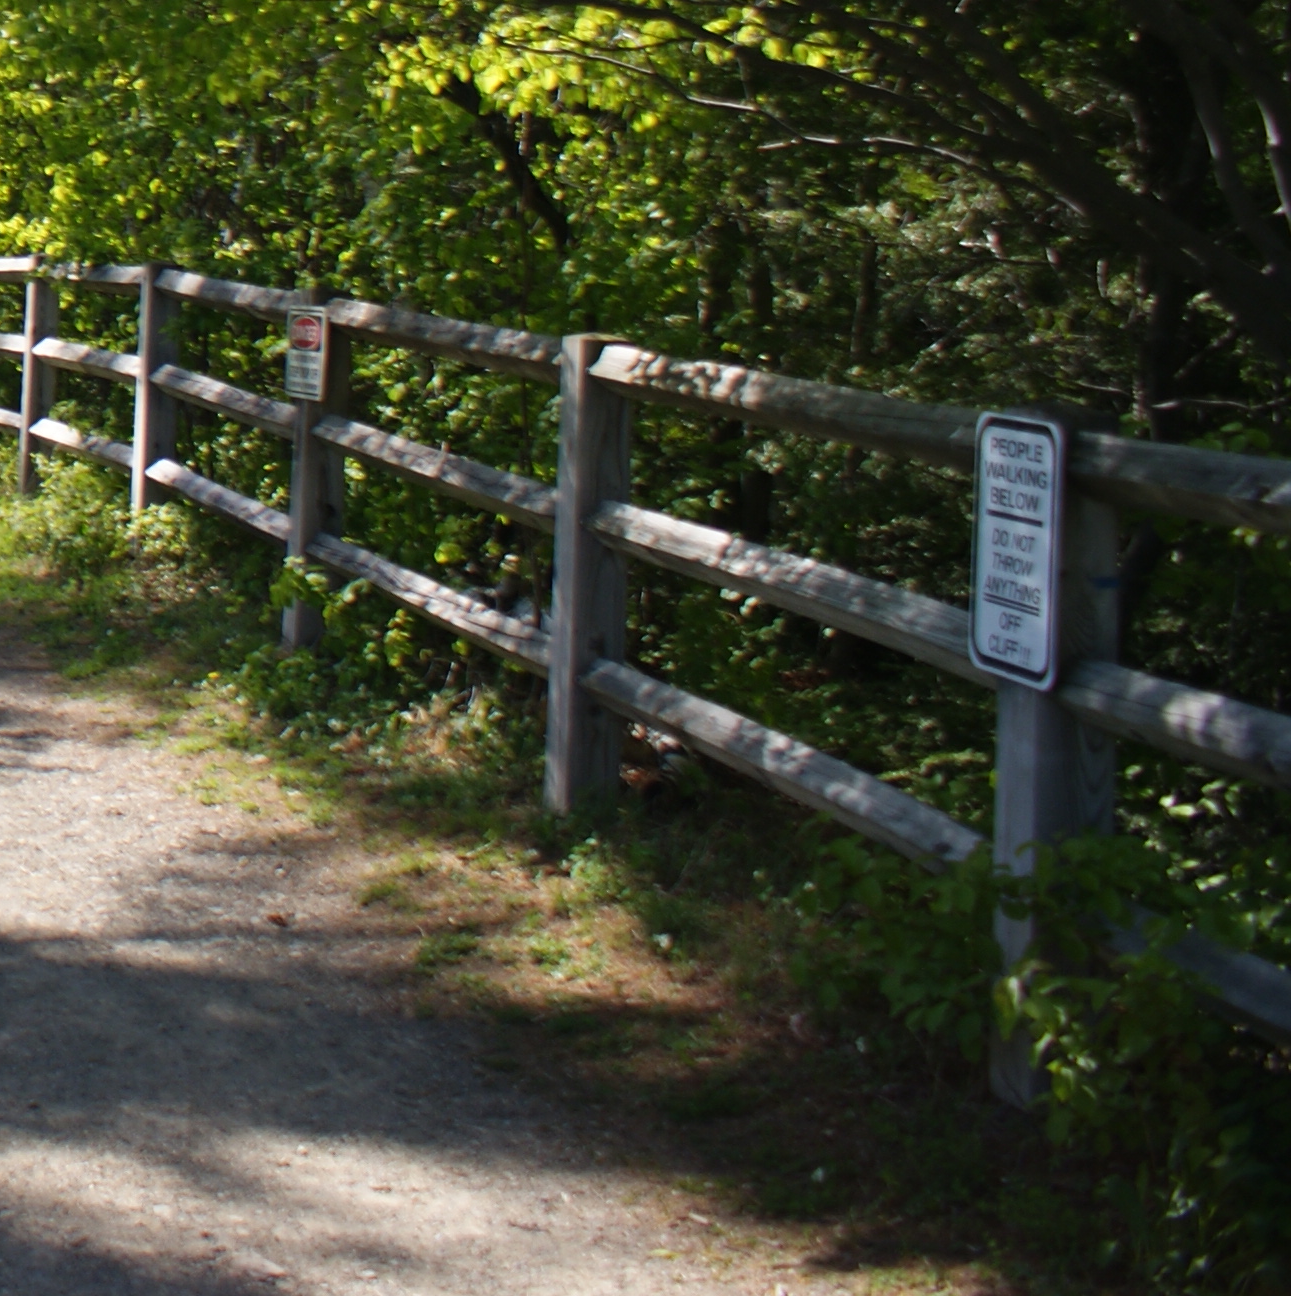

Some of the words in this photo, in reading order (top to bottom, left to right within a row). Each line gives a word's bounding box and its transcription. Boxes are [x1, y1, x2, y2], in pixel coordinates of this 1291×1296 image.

[990, 437, 1043, 464] PEOPLE
[985, 461, 1047, 489] WALKING
[990, 488, 1039, 512] BELOW
[993, 528, 1009, 547] DO
[1011, 532, 1035, 552] NOT
[993, 552, 1034, 576] THROW
[985, 575, 1041, 604] ANYTHING
[999, 612, 1022, 632] OFF
